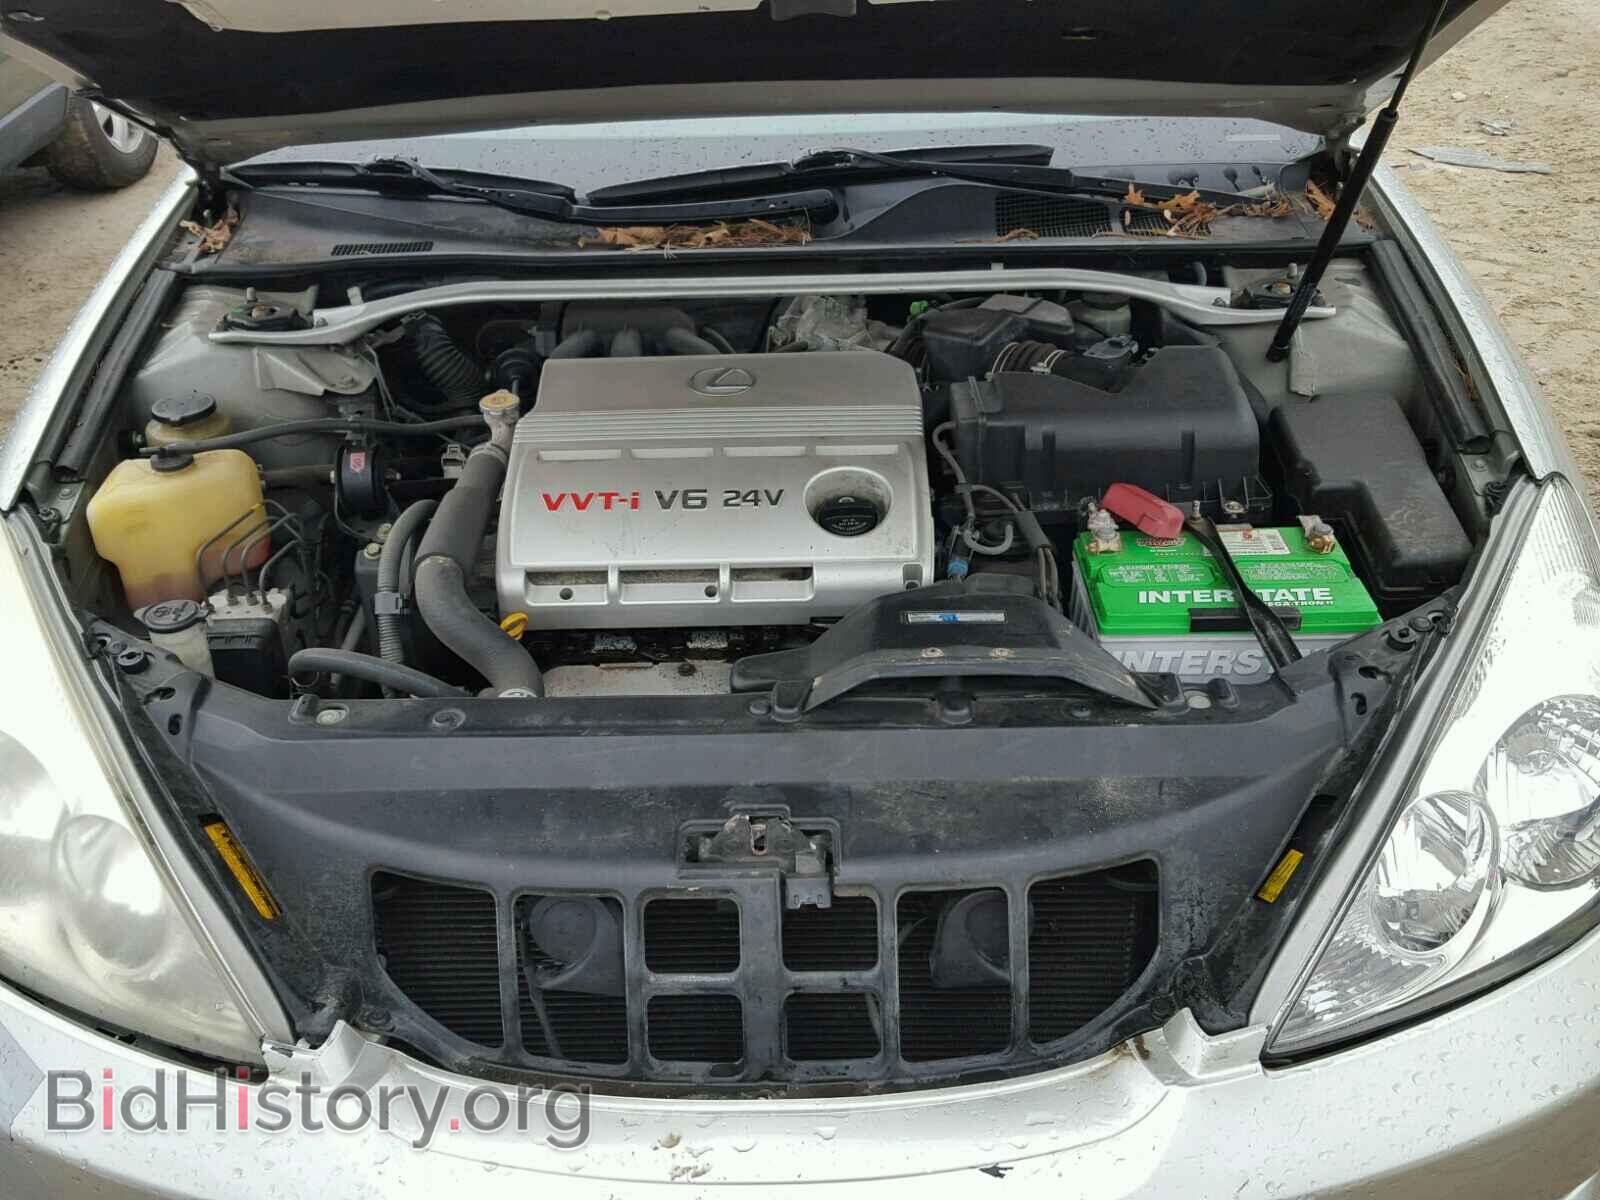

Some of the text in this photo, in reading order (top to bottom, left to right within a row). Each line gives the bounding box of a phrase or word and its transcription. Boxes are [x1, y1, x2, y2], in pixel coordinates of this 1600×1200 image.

[542, 488, 785, 511] VVT-i V6 24V
[1138, 587, 1334, 604] INTERTATE
